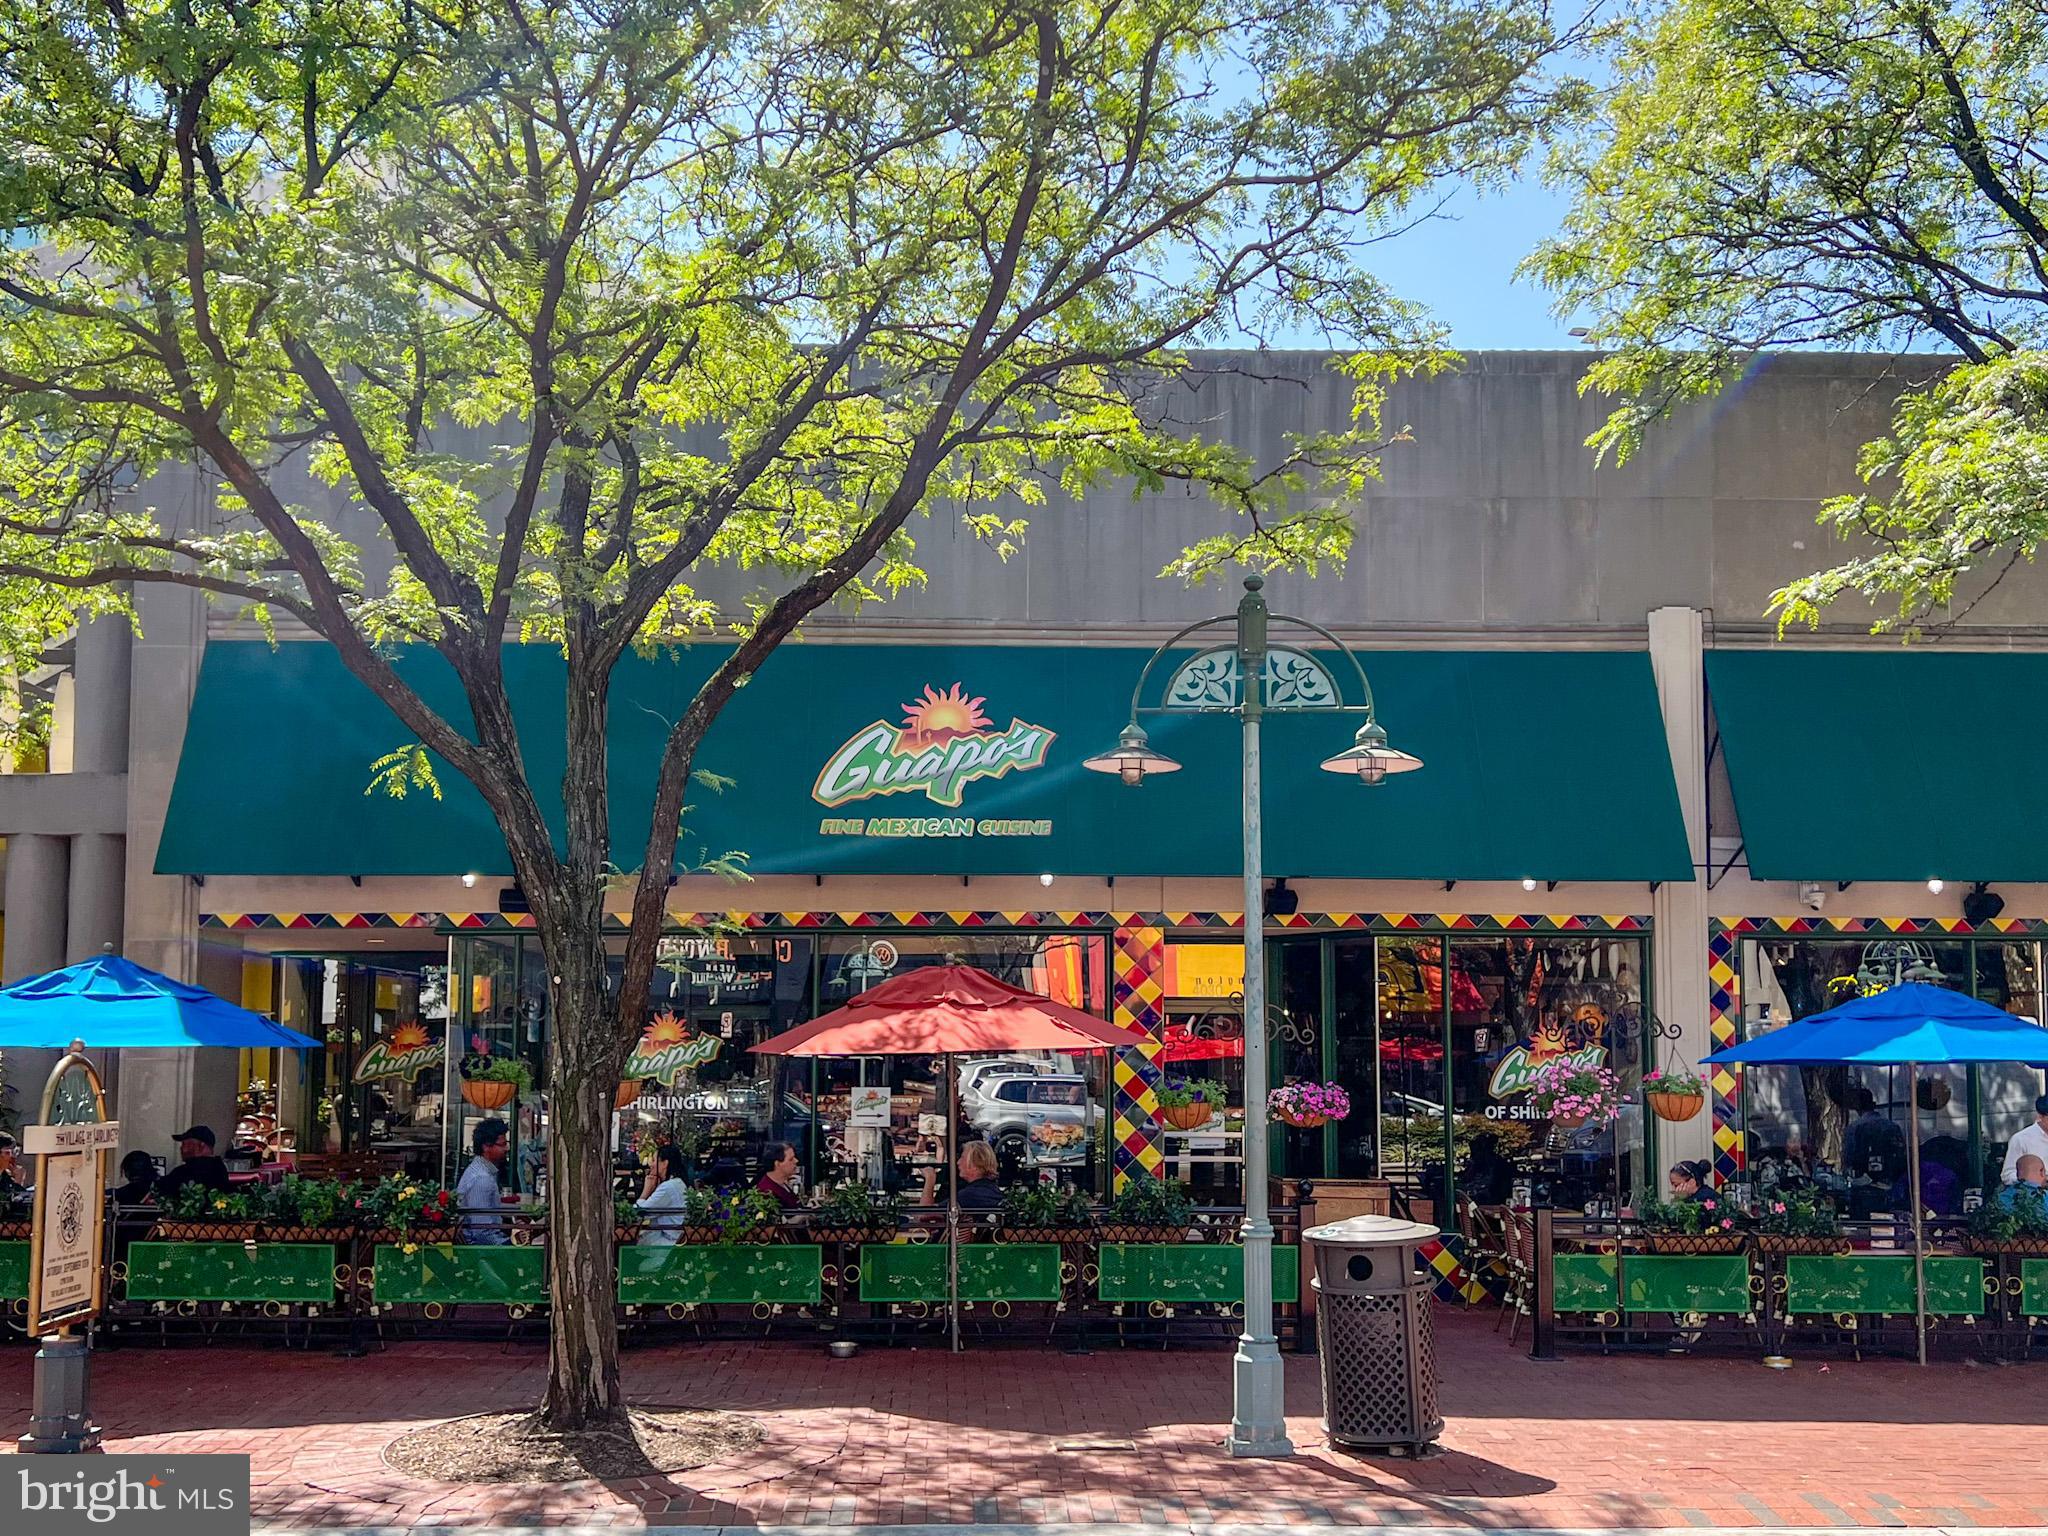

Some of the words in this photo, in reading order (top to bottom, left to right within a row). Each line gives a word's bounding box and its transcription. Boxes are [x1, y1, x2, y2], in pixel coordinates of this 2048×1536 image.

[818, 726, 1041, 799] Guapo's
[820, 818, 864, 835] FINE
[866, 818, 974, 837] MEXICAN
[977, 819, 1052, 836] CUISINE
[628, 1036, 717, 1083] uapo's
[1490, 1046, 1603, 1094] Guao's
[620, 1096, 729, 1111] HIRLINGTON
[1484, 1105, 1507, 1120] OF
